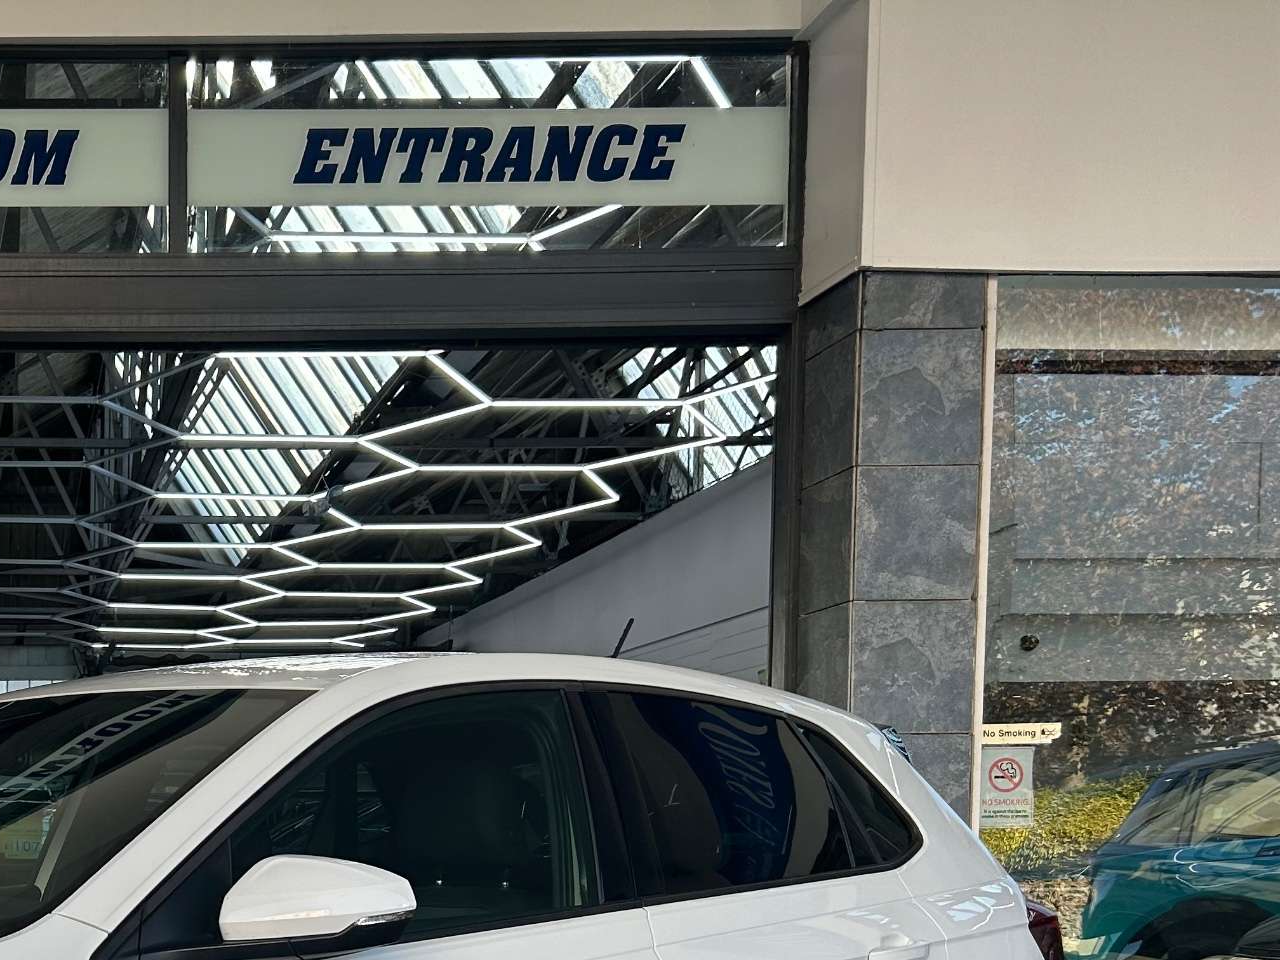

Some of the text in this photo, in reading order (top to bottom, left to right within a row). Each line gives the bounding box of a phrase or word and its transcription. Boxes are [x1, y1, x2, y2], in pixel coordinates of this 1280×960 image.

[292, 123, 687, 185] ENTRANCE
[983, 729, 1036, 739] No Smoking
